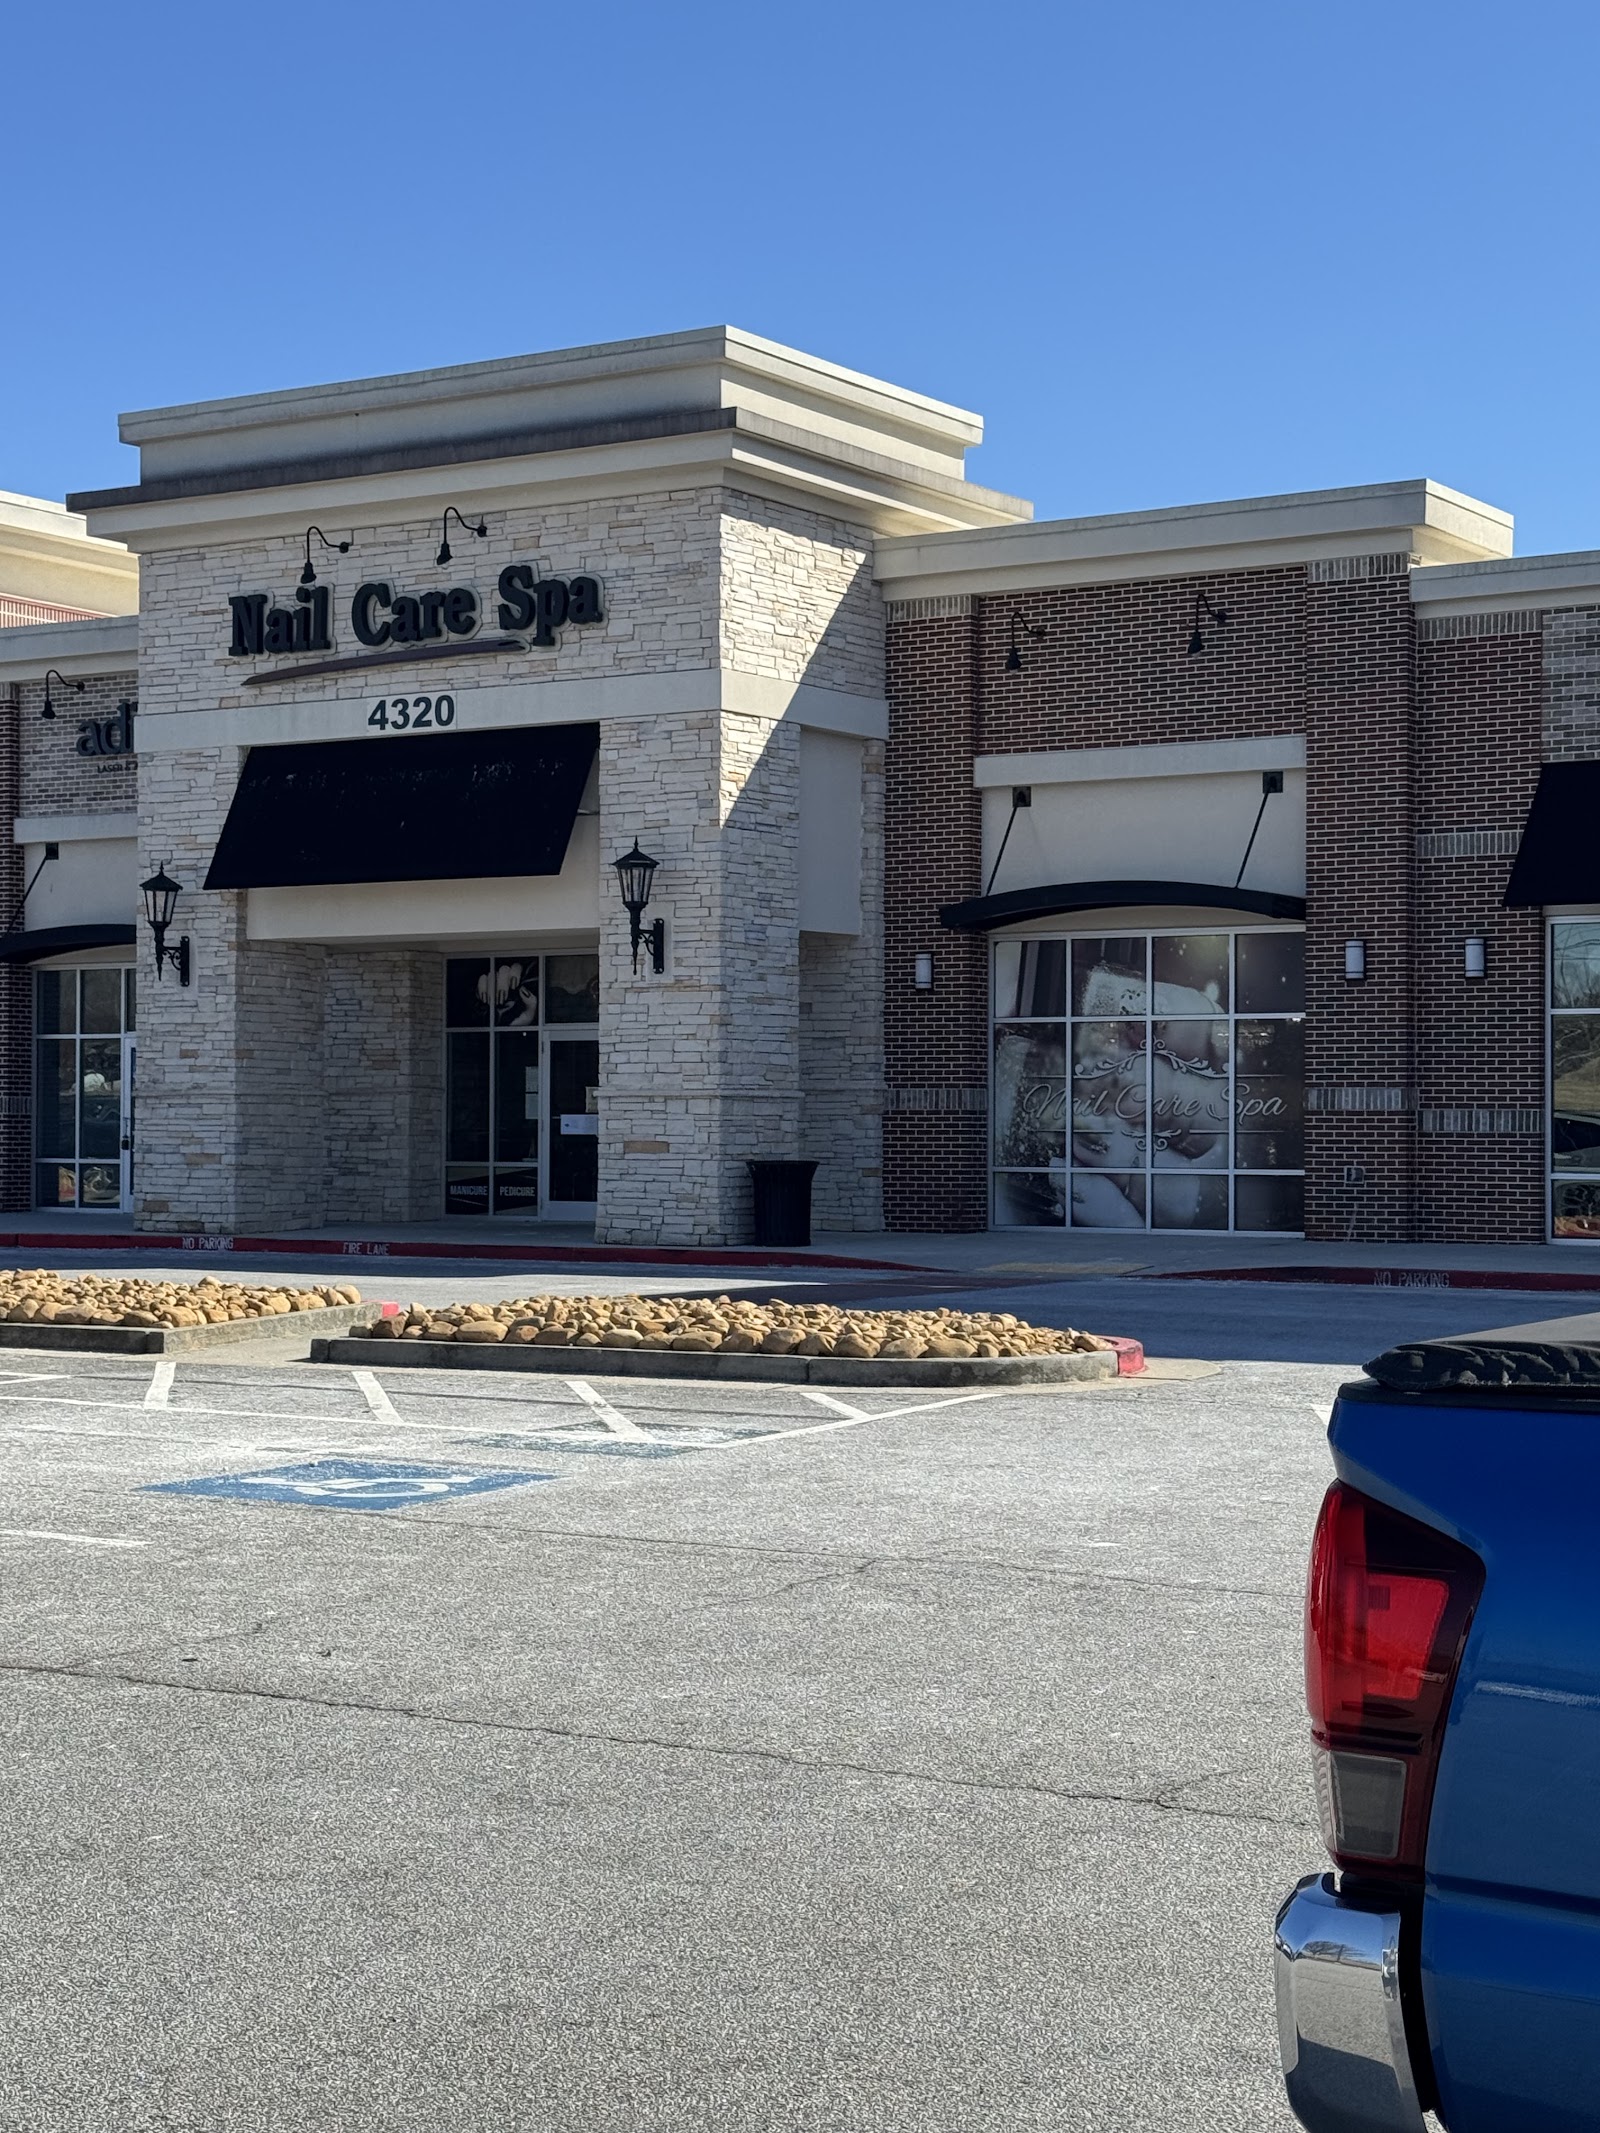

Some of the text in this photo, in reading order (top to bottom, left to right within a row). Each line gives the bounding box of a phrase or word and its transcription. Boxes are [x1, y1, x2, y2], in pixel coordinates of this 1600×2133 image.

[228, 565, 604, 656] Nail Care Spa
[368, 694, 455, 731] 4320
[1022, 1083, 1287, 1125] Nail Care Spa
[450, 1185, 489, 1196] MANICURE
[499, 1186, 536, 1197] PEDICURE
[182, 1237, 234, 1249] NO PARKING
[343, 1242, 390, 1256] FIRE LANE
[1374, 1270, 1450, 1288] NO PARKING
